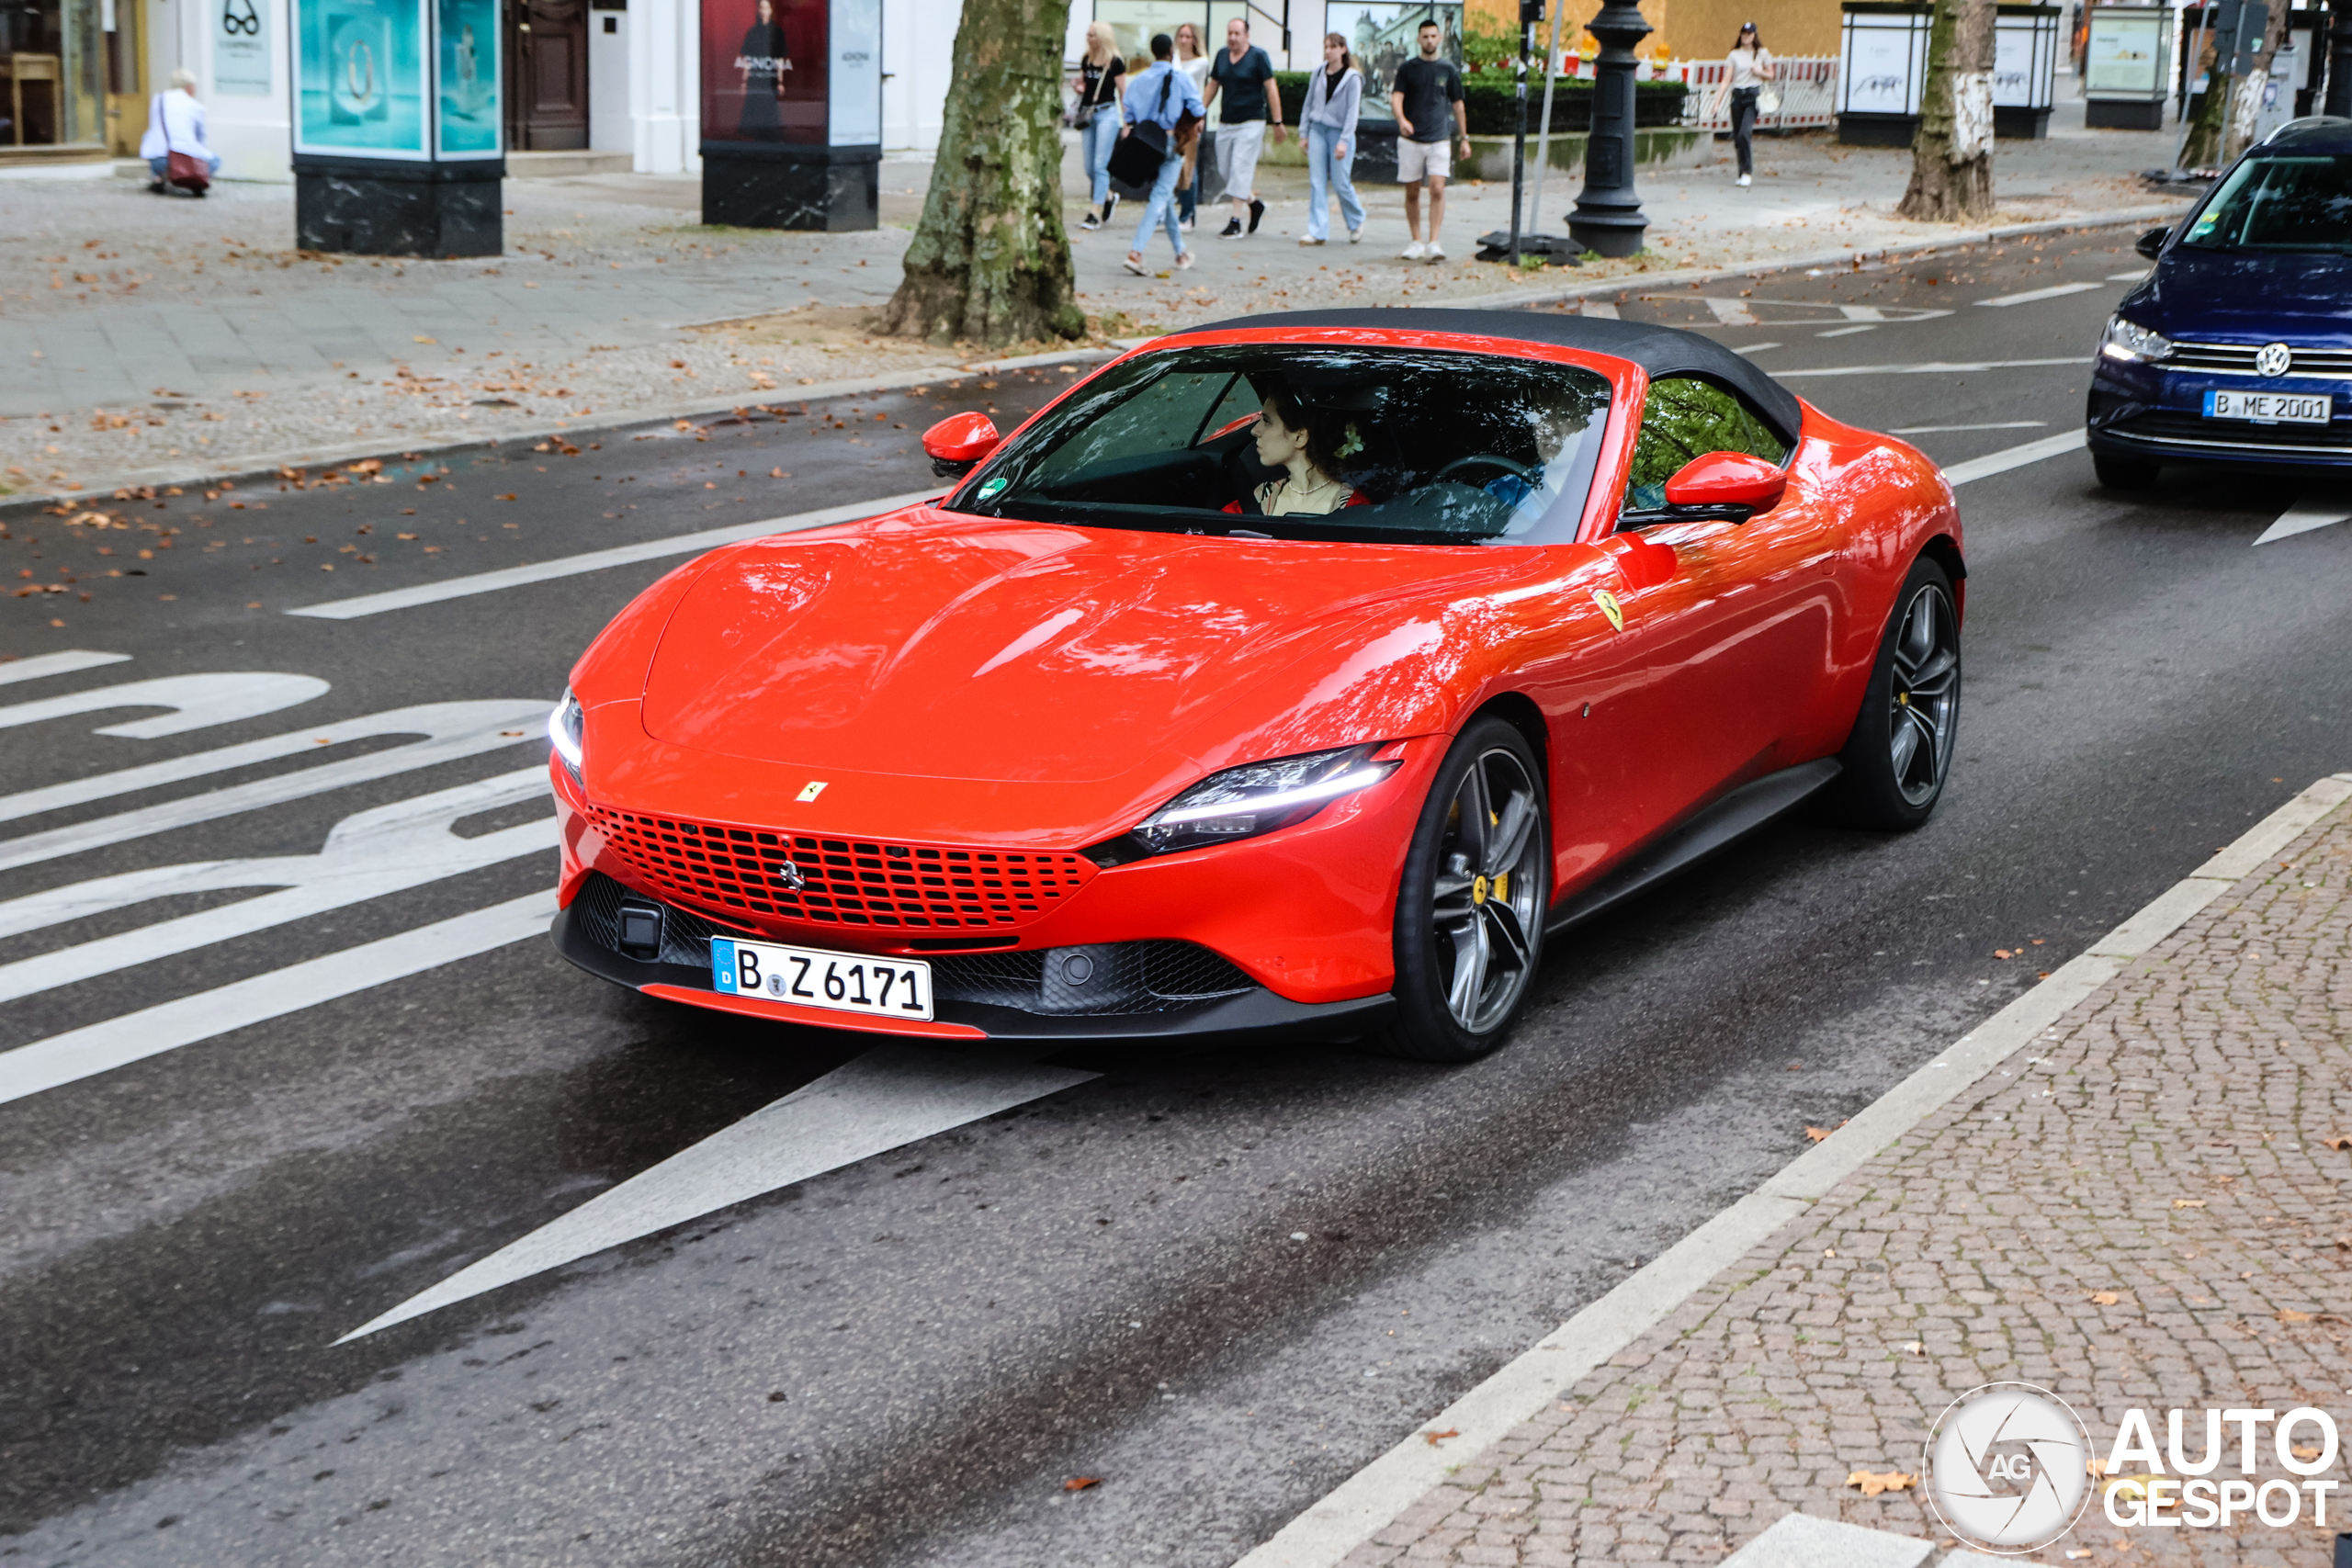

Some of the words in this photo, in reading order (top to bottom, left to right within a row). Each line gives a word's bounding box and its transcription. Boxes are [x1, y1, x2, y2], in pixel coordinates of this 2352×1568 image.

[2217, 395, 2229, 413] B
[2244, 396, 2269, 416] ME
[2275, 399, 2326, 419] 2001
[722, 971, 731, 984] D
[738, 949, 762, 989] B
[790, 956, 814, 998] Z
[824, 961, 923, 1011] 6171
